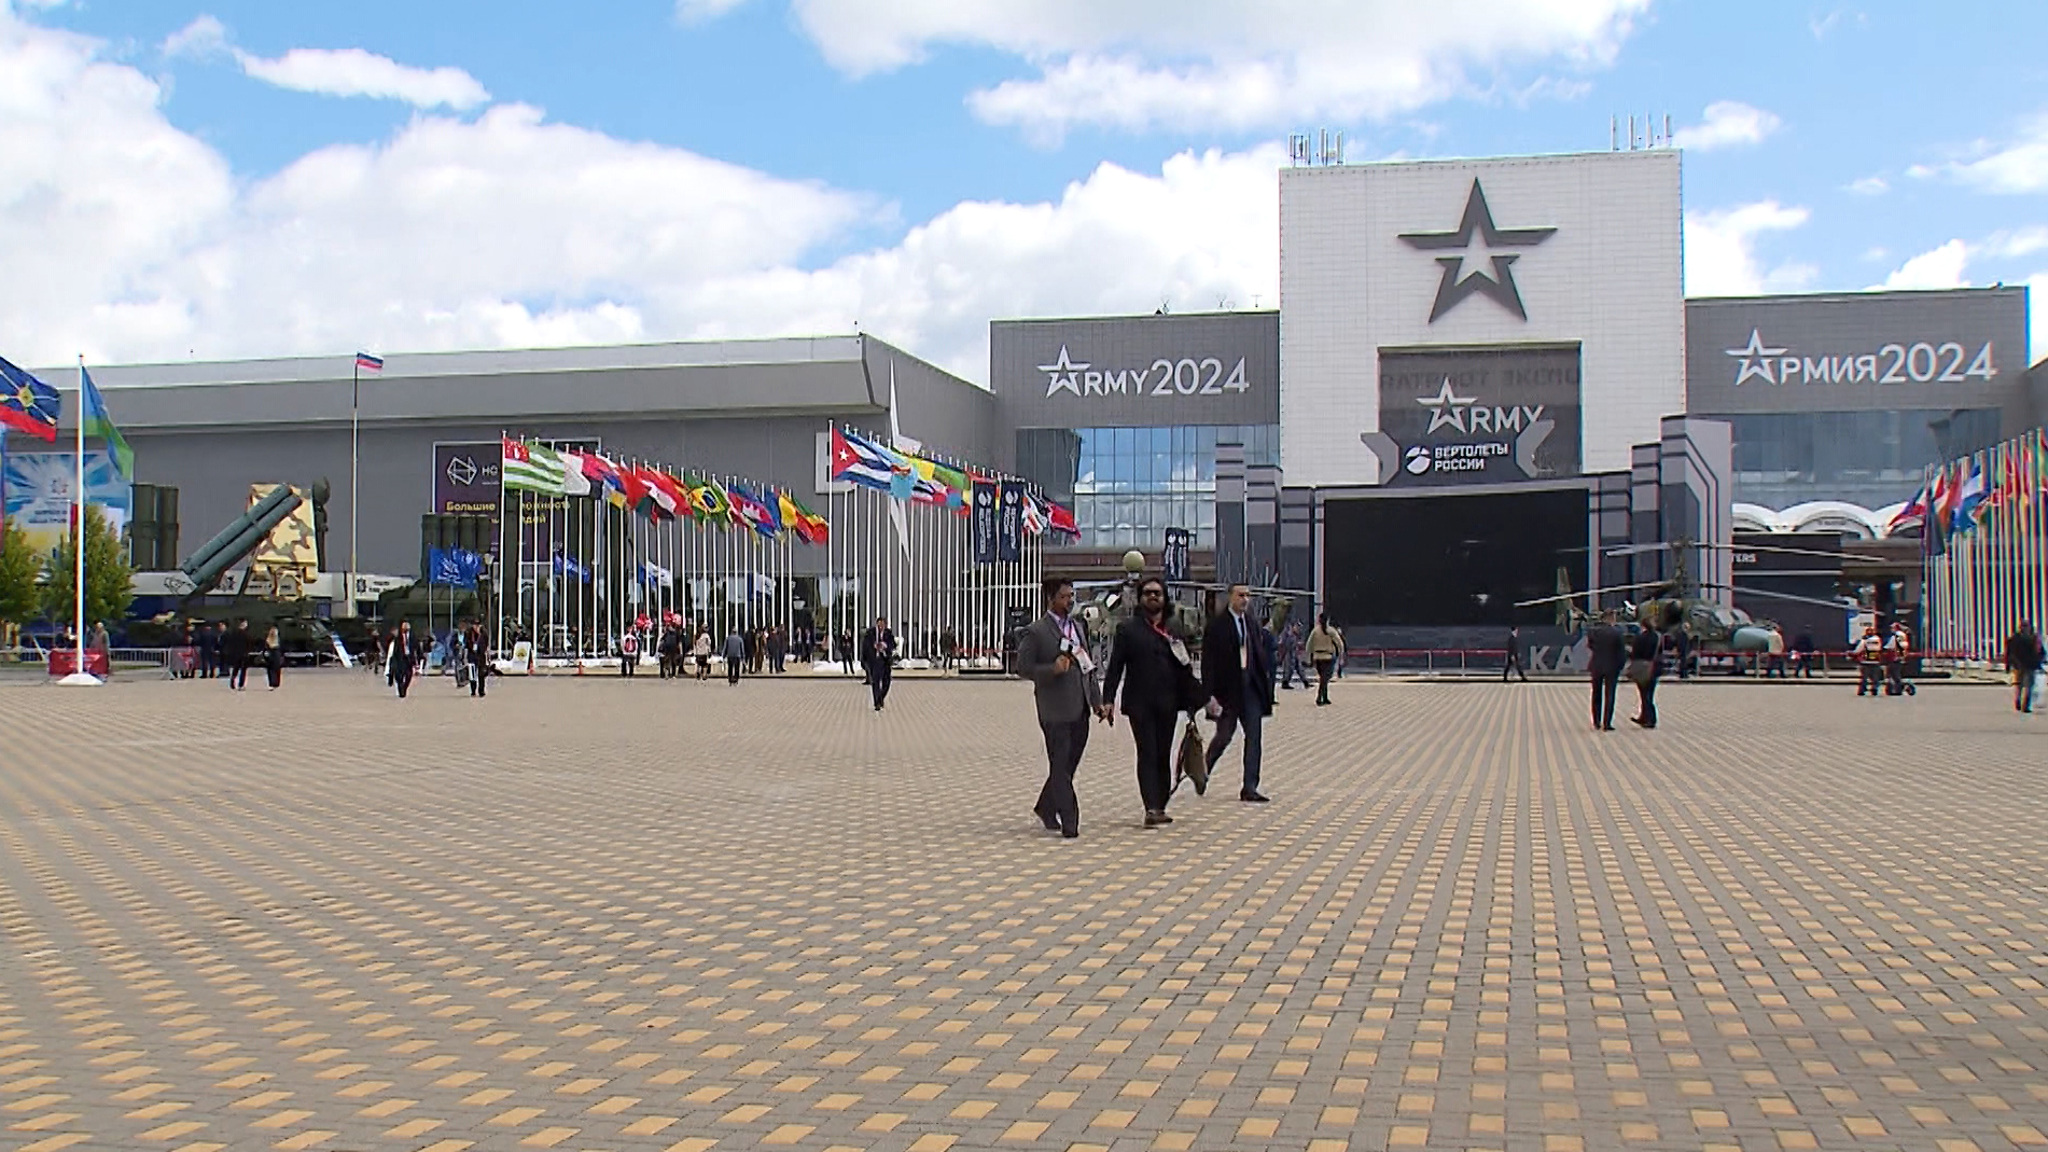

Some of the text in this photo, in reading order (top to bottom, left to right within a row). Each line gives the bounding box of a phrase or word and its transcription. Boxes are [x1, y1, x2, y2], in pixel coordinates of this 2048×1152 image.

[1878, 340, 1999, 385] 2024
[1150, 356, 1250, 397] 2024
[1434, 459, 1485, 472] РОССИИ
[446, 501, 496, 511] Большие
